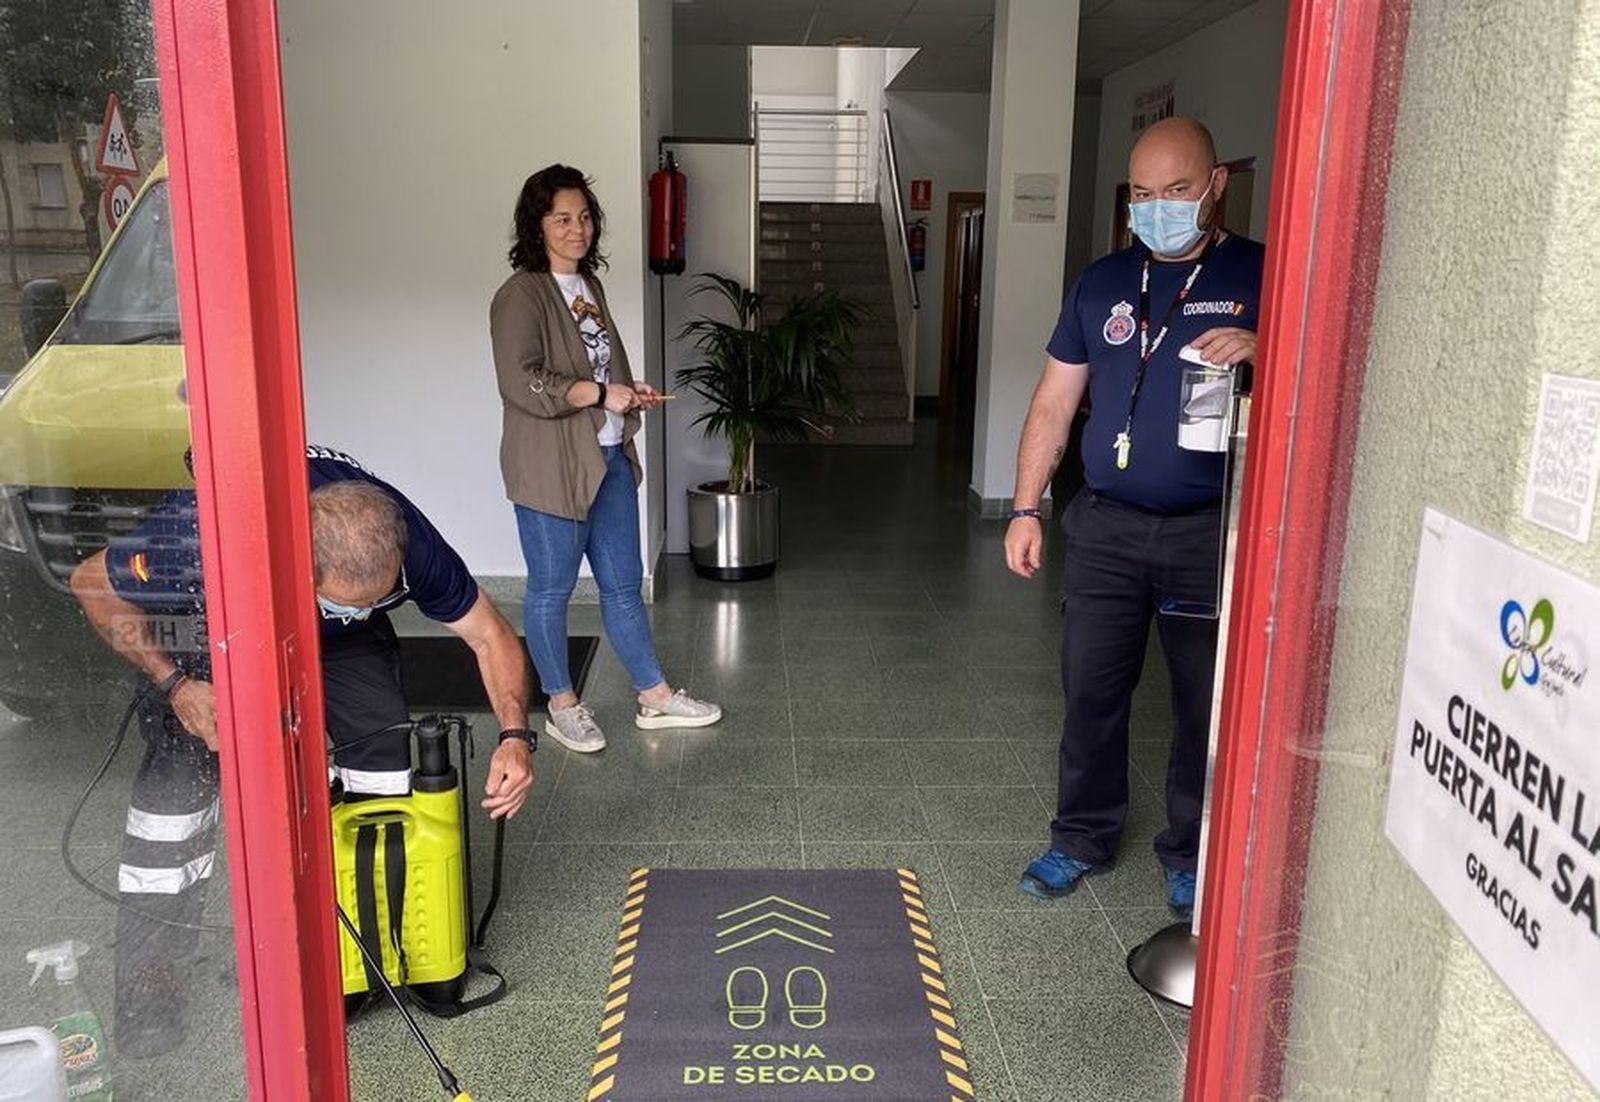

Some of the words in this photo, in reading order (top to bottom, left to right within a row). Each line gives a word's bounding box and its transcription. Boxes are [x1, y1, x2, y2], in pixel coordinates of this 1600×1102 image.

[1183, 301, 1235, 316] COORDINADOR
[1447, 695, 1565, 825] CIERREN
[1410, 719, 1498, 839] PUERTA
[1504, 812, 1543, 880] AL
[1465, 852, 1542, 950] GRACIAS
[684, 1067, 725, 1085] DE
[735, 1064, 876, 1084] SECADO
[732, 1045, 825, 1060] ZONA
